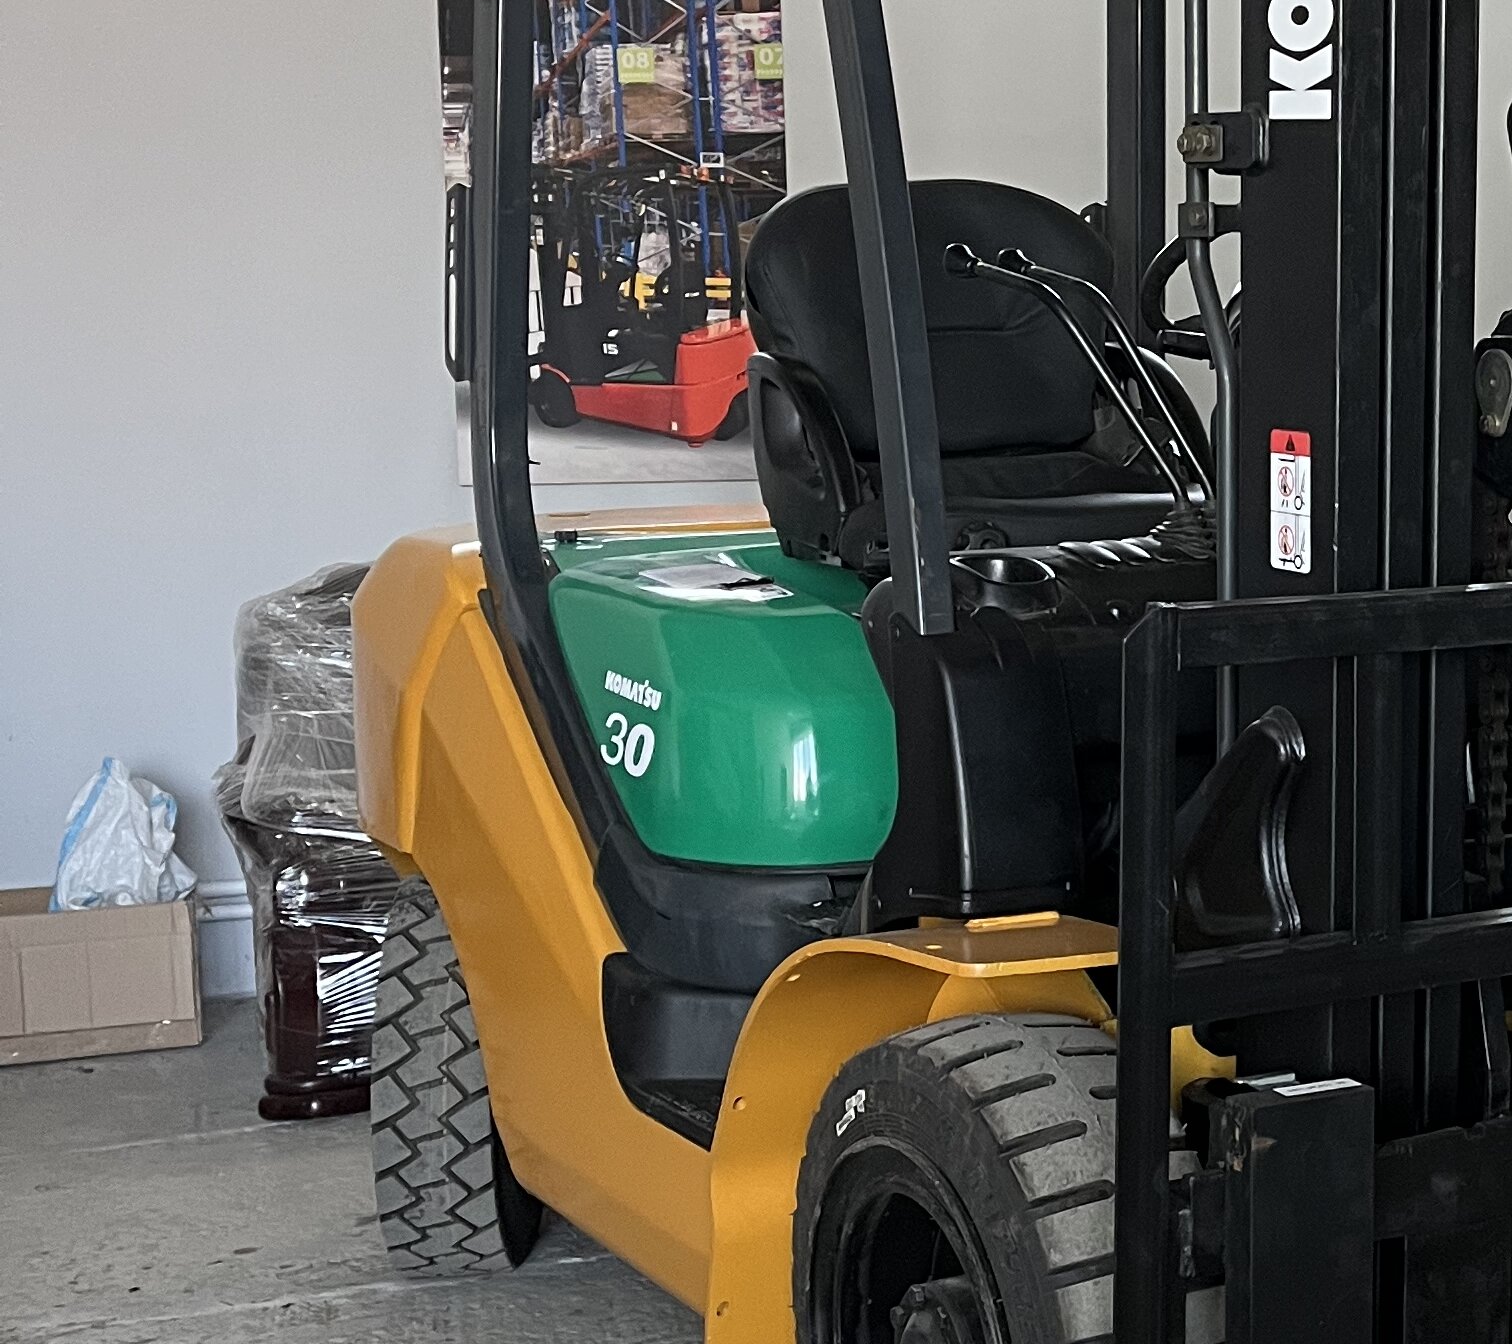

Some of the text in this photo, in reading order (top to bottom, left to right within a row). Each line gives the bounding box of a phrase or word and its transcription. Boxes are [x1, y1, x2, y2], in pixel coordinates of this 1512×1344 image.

[620, 51, 651, 70] 08
[602, 343, 619, 355] 15
[604, 669, 662, 711] KOMATSU
[600, 712, 656, 778] 30
